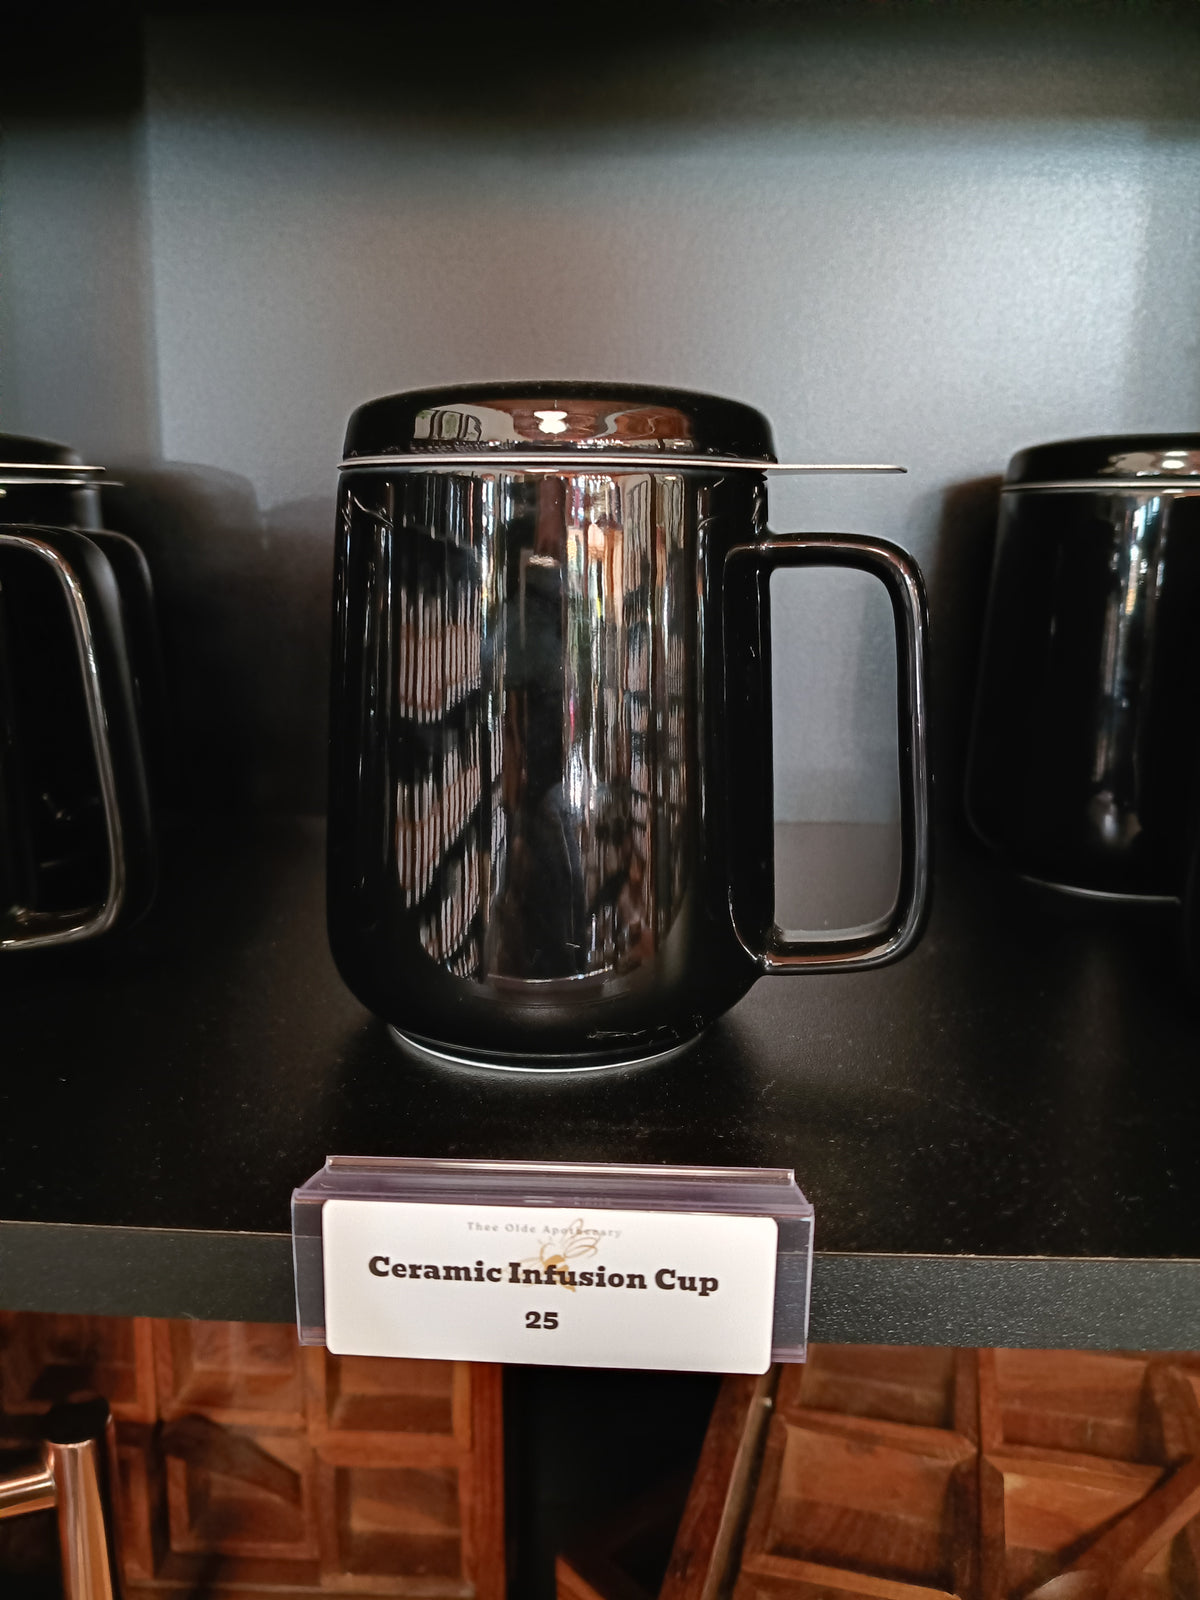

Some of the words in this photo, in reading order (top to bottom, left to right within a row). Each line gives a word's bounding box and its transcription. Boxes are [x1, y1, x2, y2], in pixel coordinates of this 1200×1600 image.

[467, 1221, 499, 1232] Thee
[505, 1223, 536, 1234] Olde
[368, 1255, 503, 1284] Ceramic
[508, 1262, 648, 1290] Infusion
[655, 1269, 719, 1297] Cup
[524, 1311, 559, 1331] 25
